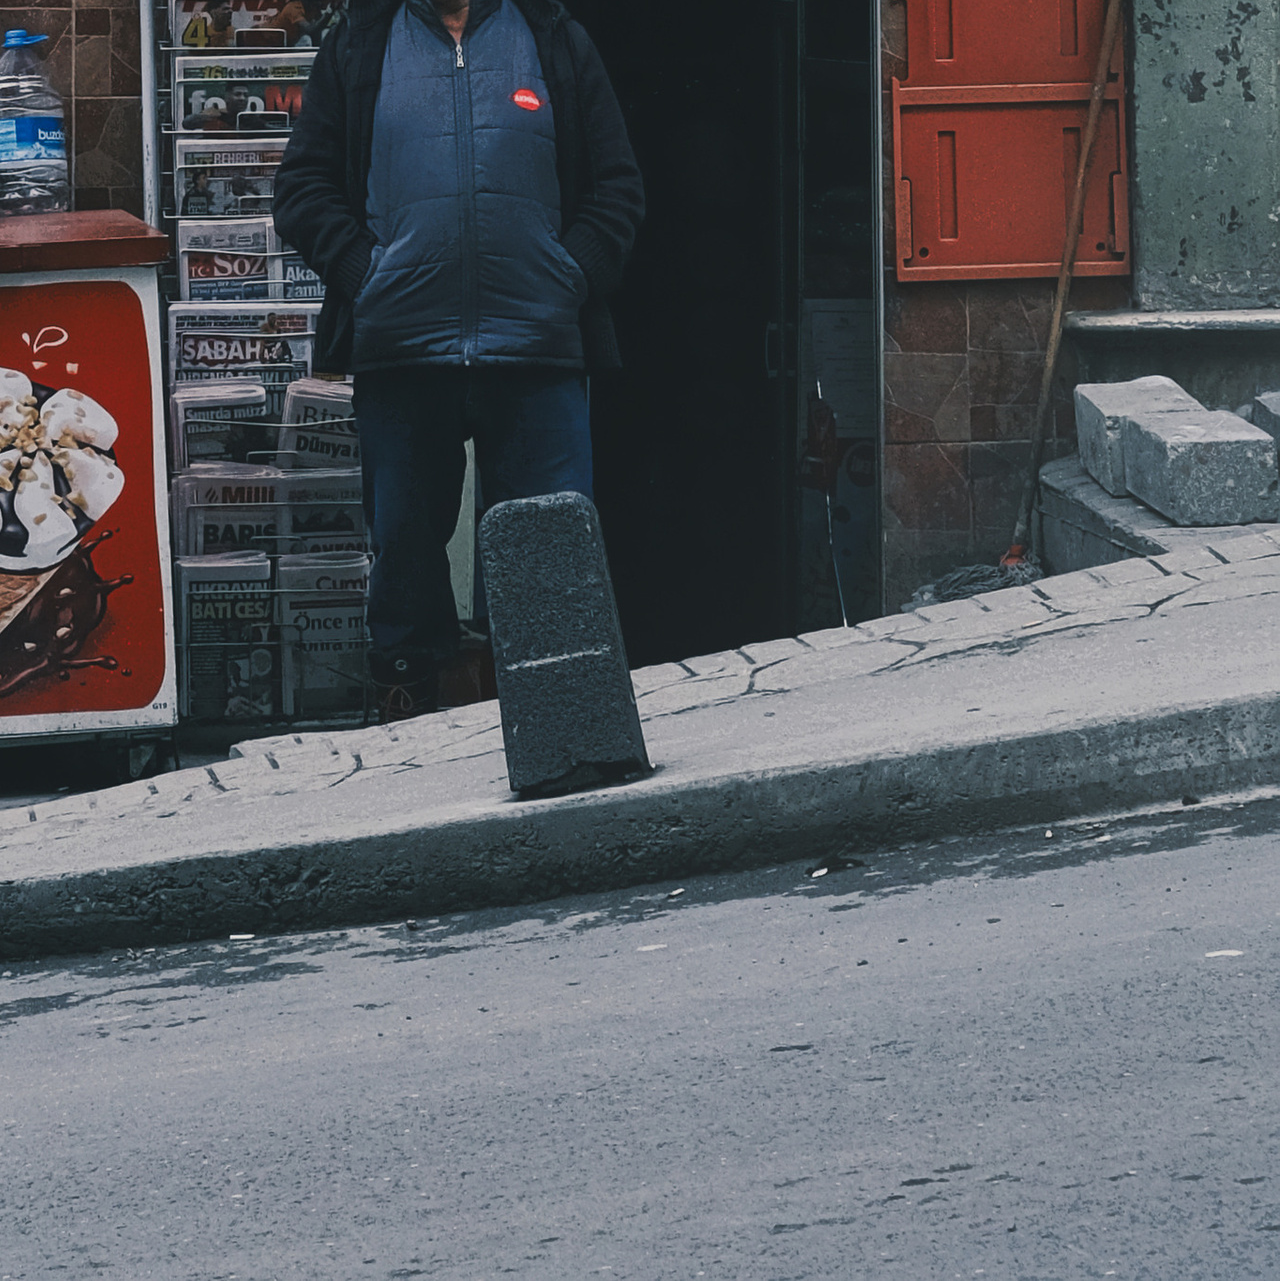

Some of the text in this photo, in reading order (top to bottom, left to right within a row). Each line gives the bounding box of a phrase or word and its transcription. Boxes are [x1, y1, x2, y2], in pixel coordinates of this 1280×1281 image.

[183, 16, 209, 47] 4
[183, 339, 261, 361] SABAH
[296, 434, 351, 459] Dünya
[192, 602, 231, 620] BATI
[293, 611, 344, 631] Önce
[152, 703, 167, 713] G19
